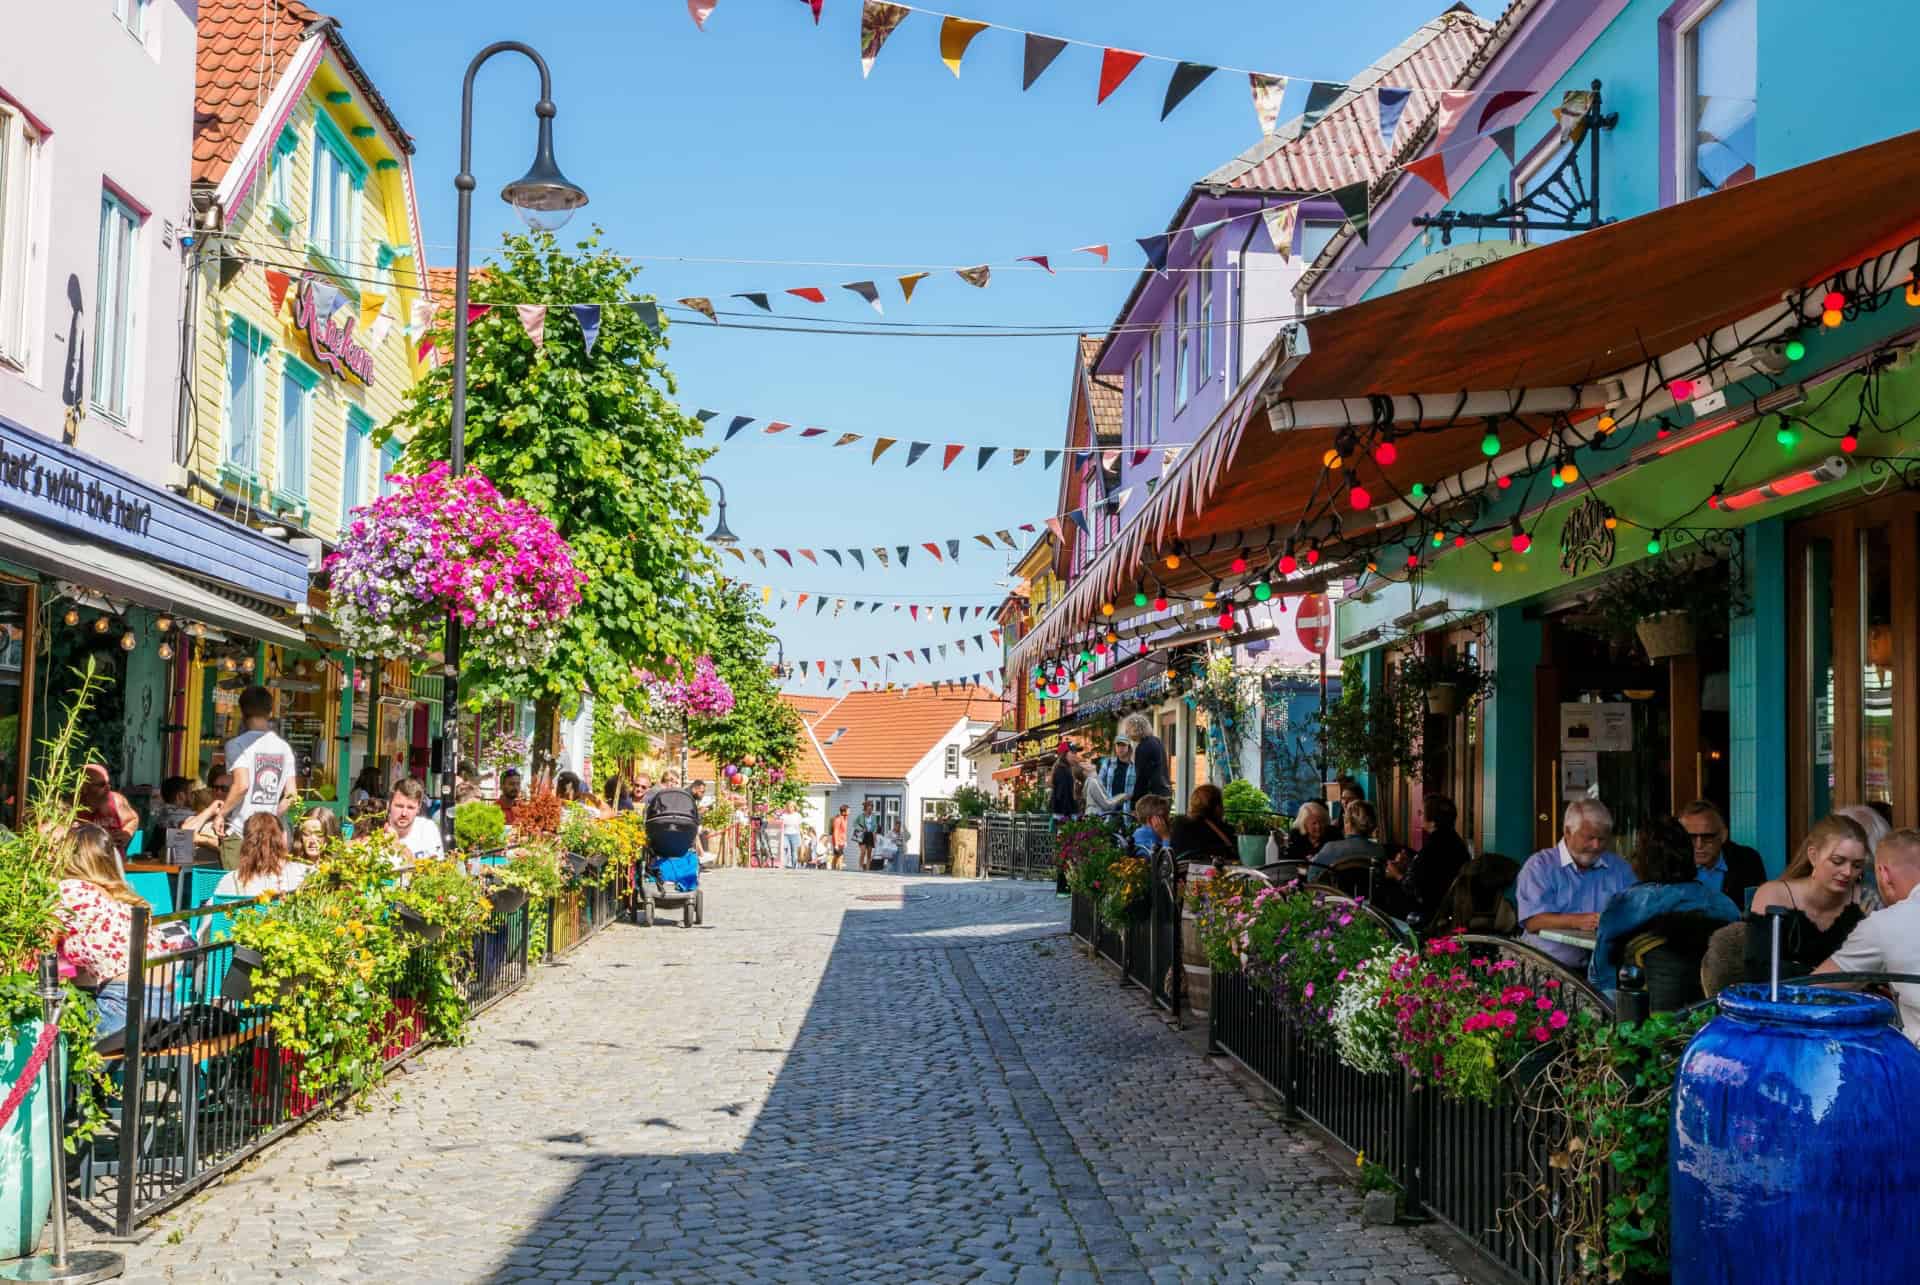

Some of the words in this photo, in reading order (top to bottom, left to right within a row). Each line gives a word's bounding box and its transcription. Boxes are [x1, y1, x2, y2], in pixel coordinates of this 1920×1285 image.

[47, 467, 83, 515] with
[87, 480, 113, 523] the
[116, 489, 152, 538] hair?
